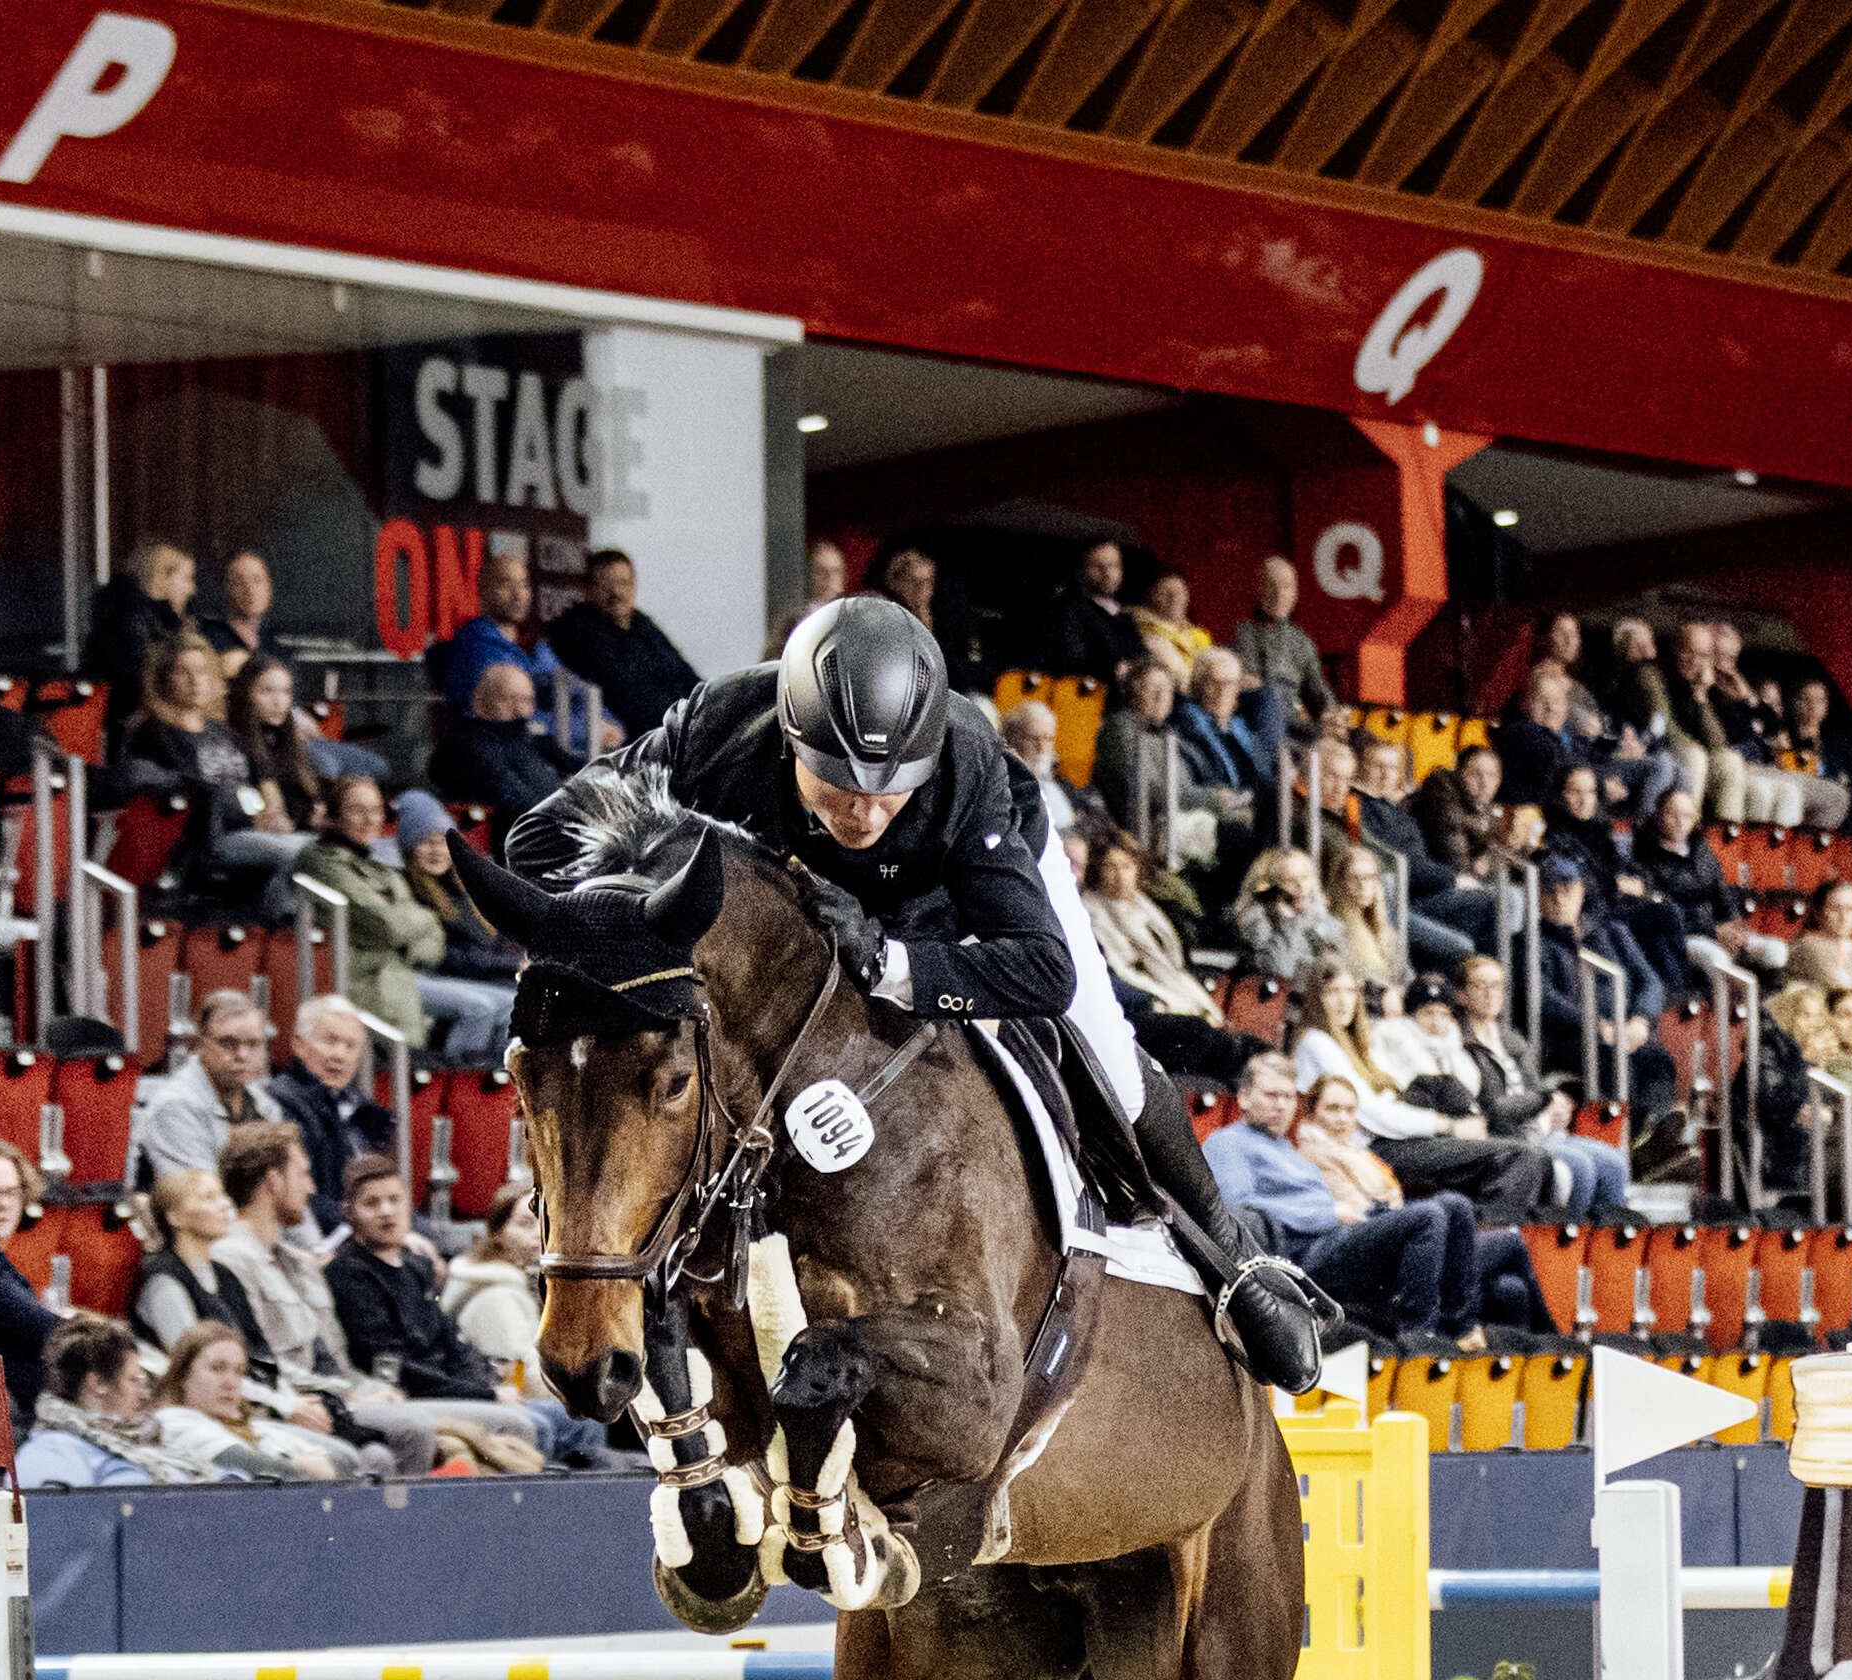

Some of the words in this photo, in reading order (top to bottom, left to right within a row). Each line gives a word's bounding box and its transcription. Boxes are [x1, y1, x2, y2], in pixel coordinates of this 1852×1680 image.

[1353, 248, 1483, 405] Q
[414, 357, 649, 518] STAGE
[1314, 522, 1384, 602] Q
[803, 1090, 863, 1160] 1094
